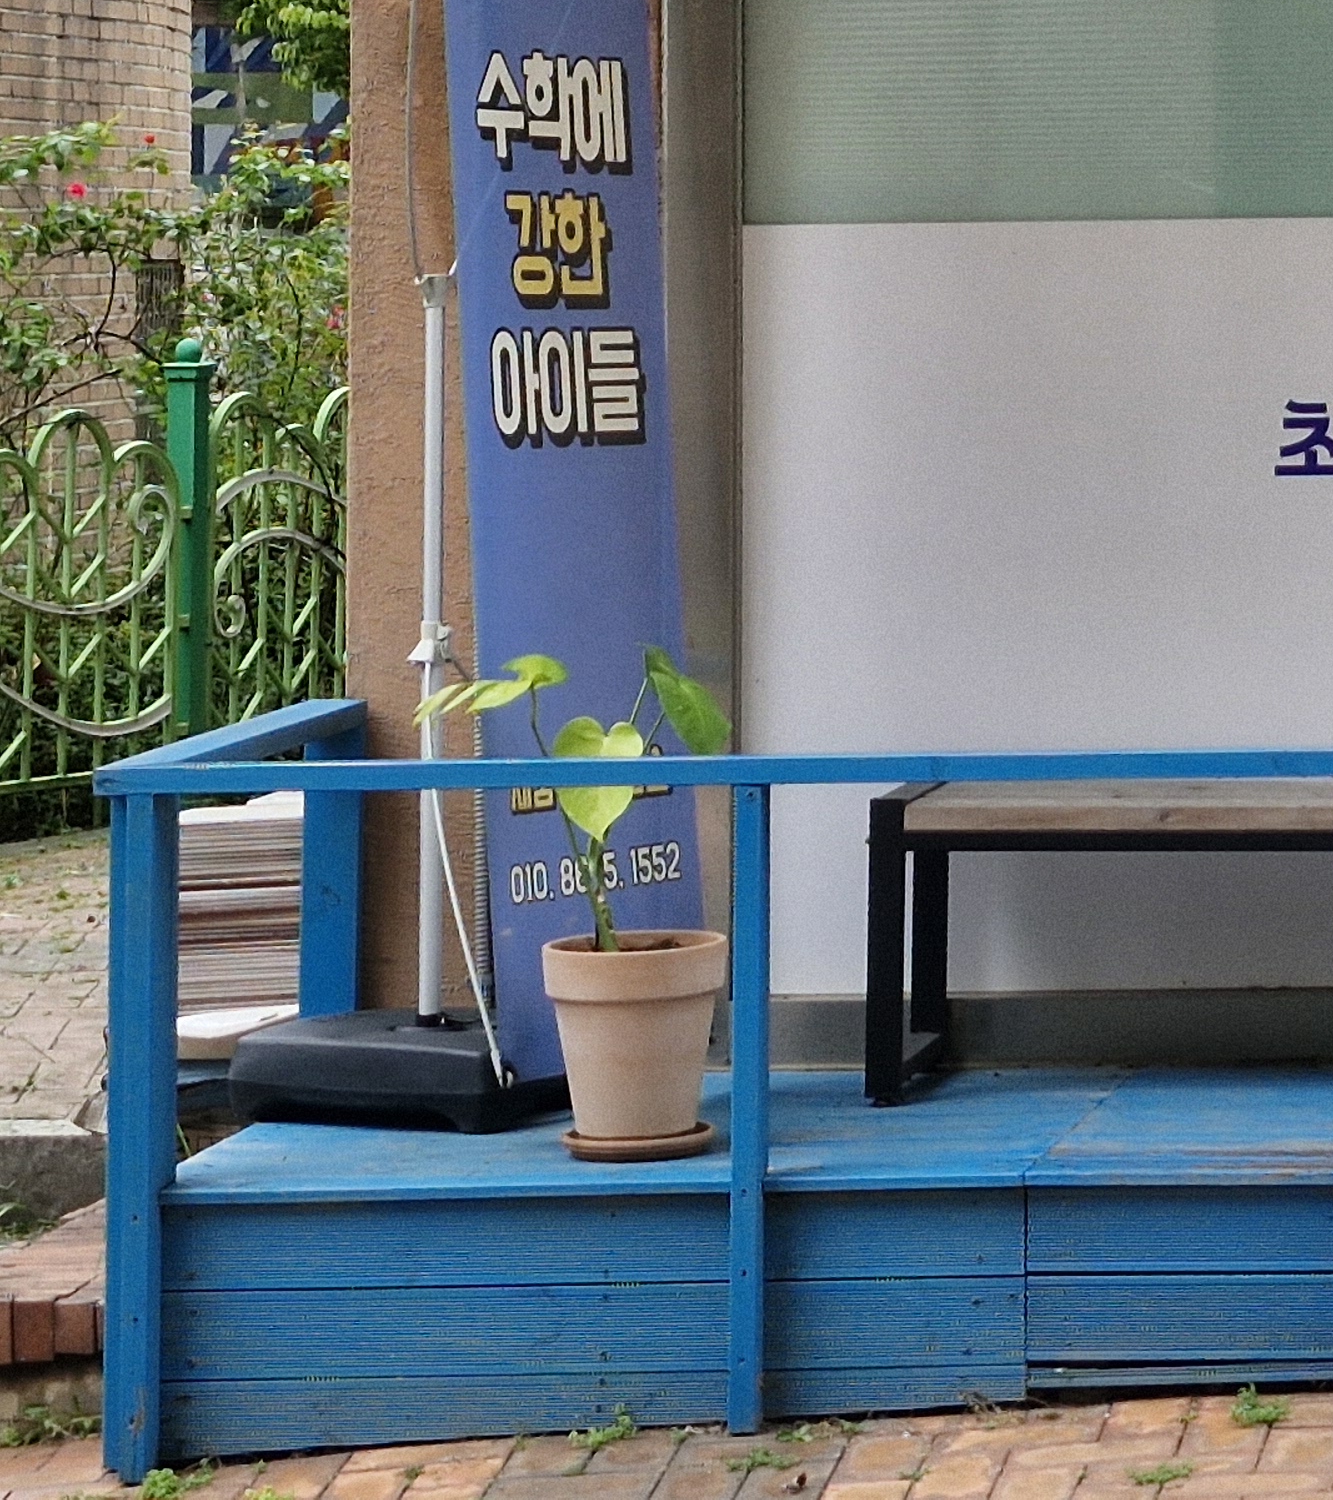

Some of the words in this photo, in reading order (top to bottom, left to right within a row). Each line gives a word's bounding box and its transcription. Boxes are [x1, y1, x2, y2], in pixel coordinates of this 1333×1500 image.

[475, 51, 631, 171] 수학에
[505, 191, 609, 304] 강한
[489, 328, 644, 443] 아이들
